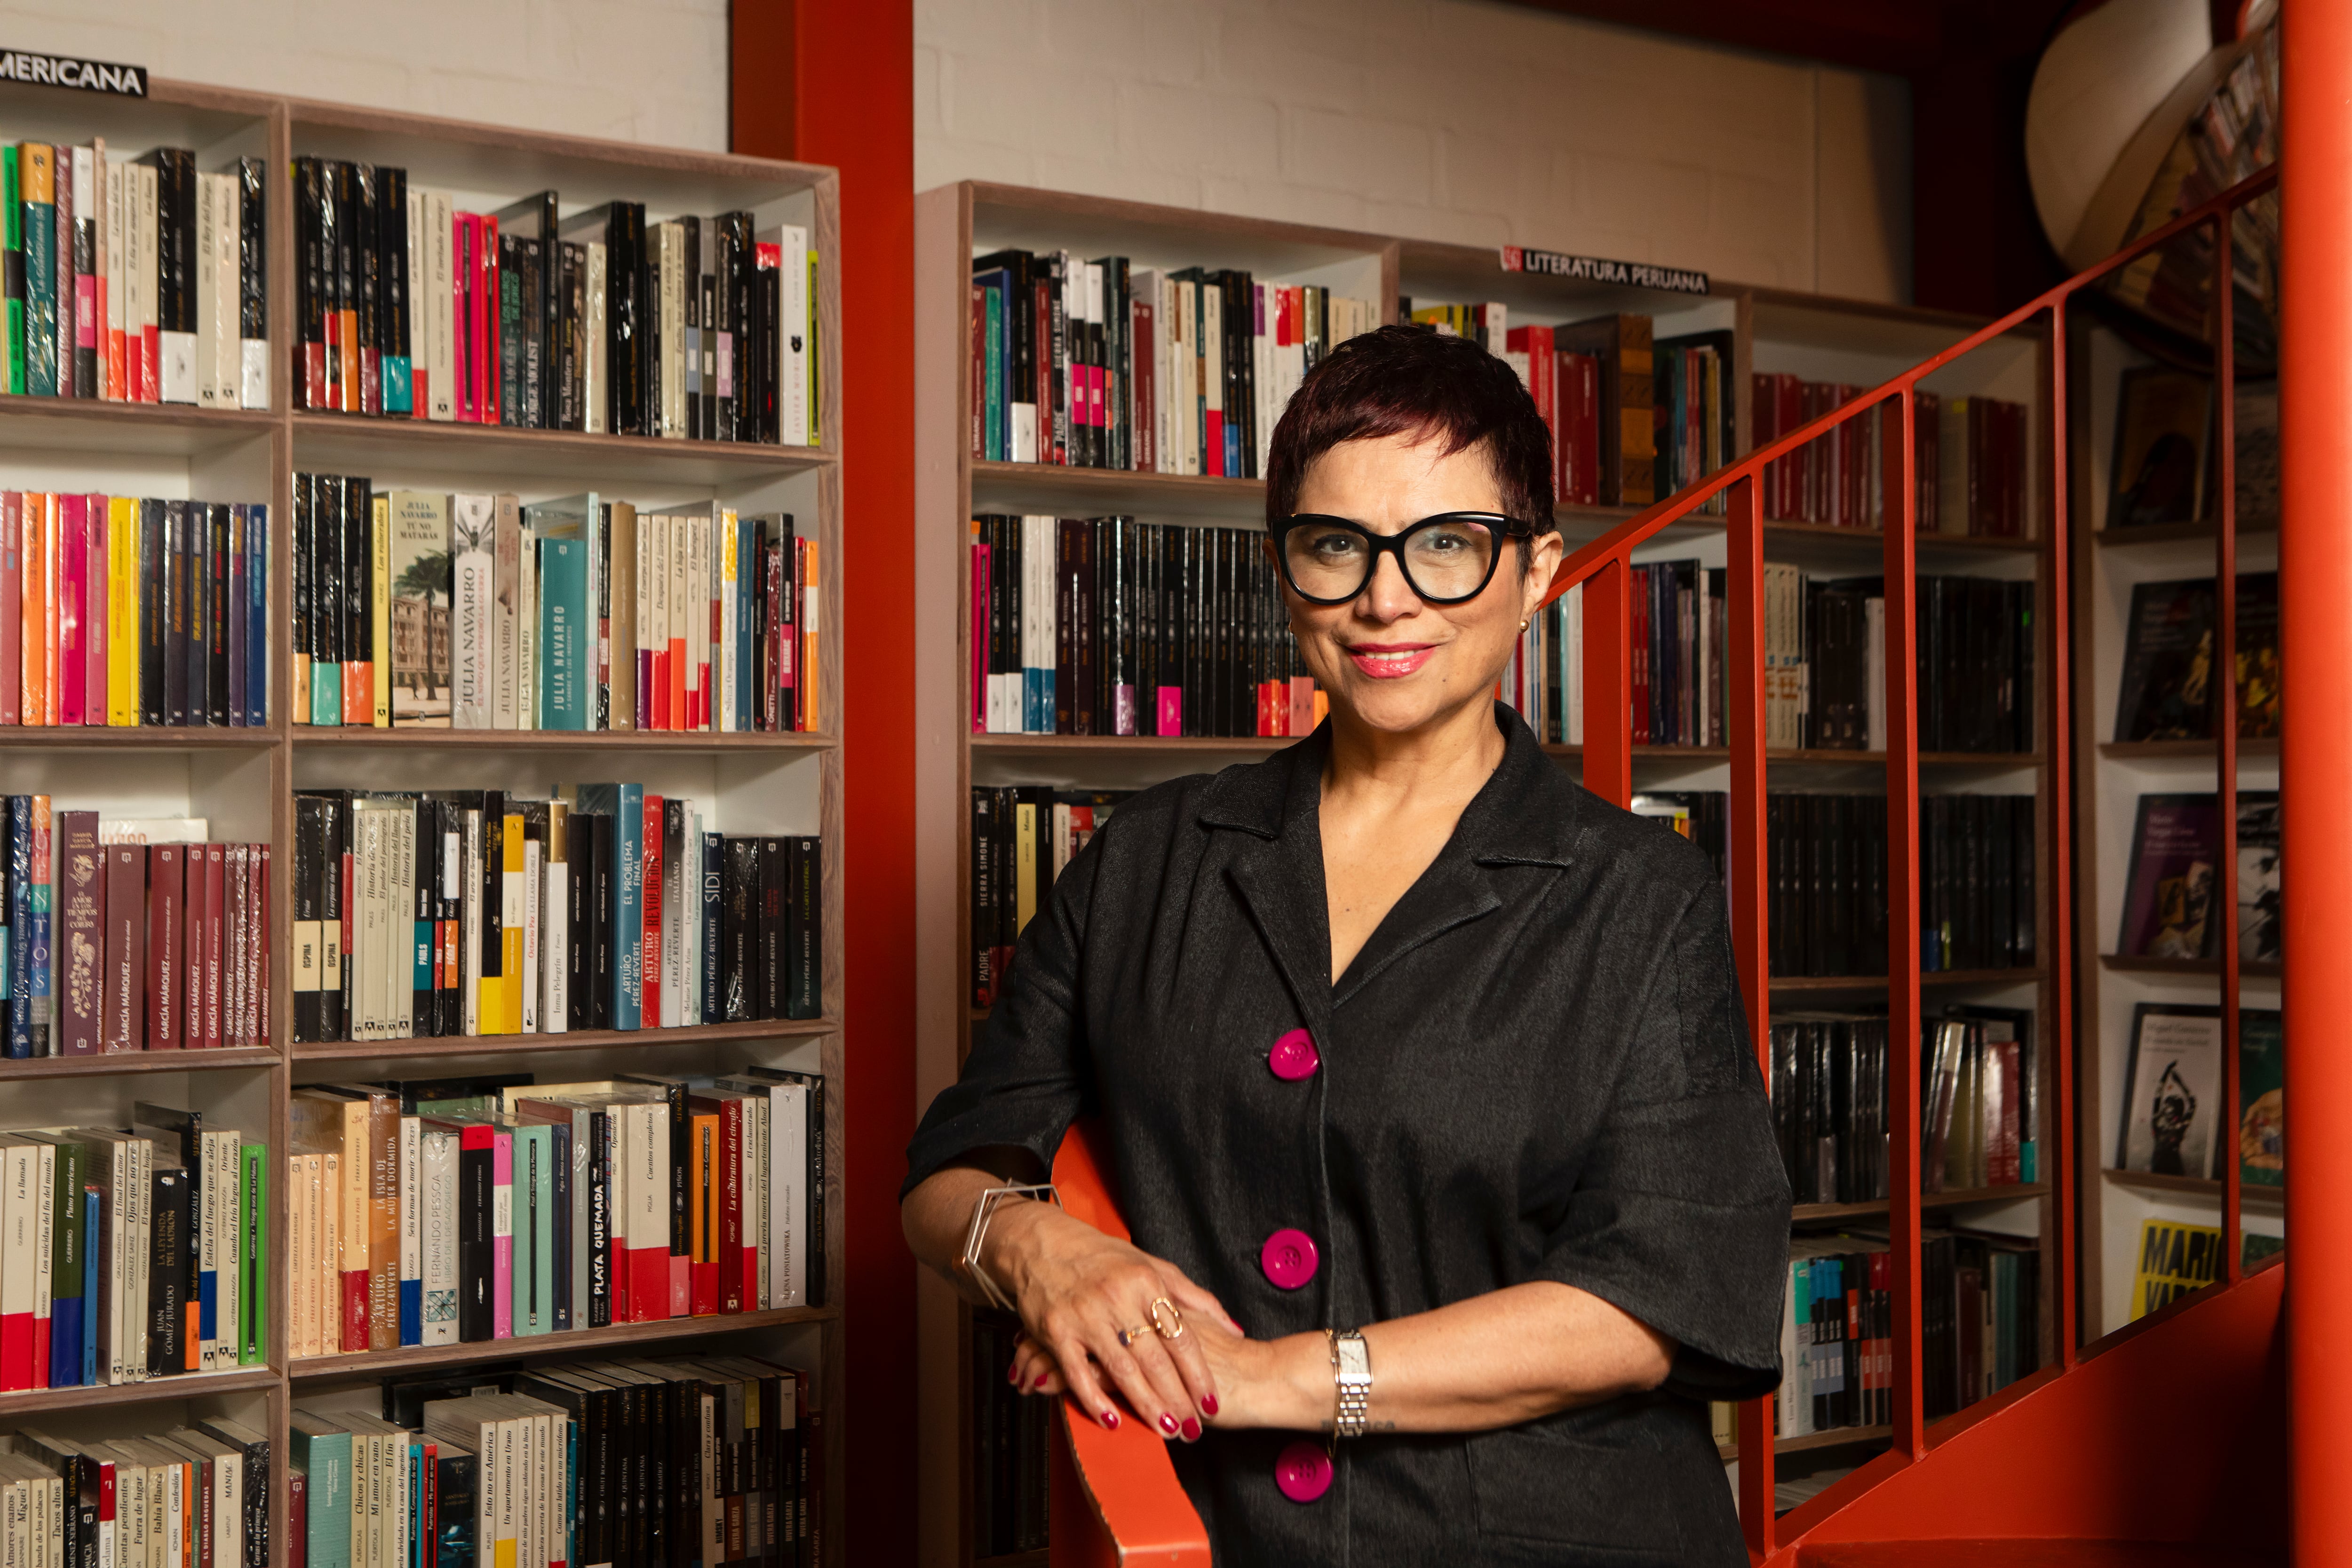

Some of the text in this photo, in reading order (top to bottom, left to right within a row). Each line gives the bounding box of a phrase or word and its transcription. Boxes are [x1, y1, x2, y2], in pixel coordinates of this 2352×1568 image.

[1526, 252, 1628, 283] LITERATURA
[1632, 266, 1707, 293] PERUANA
[504, 336, 516, 424] JORGE MOLIST
[527, 339, 538, 383] MOLIST
[527, 386, 538, 424] JORGE
[561, 355, 573, 422] Rosa Montero
[376, 506, 385, 551] vulnerables
[656, 560, 664, 572] del
[675, 567, 683, 578] La
[478, 605, 484, 616] LA
[657, 574, 666, 610] Después
[463, 567, 475, 706] JULIA NAVARRO
[501, 620, 511, 714] JULIA NAVARRO
[554, 605, 565, 710] JULIA NAVARRO
[478, 697, 485, 706] EL
[402, 852, 411, 888] Historia
[624, 841, 633, 904] EL PROBLEMA
[705, 872, 720, 902] SIDI
[530, 904, 534, 913] LA
[303, 944, 311, 968] OSPINA
[419, 944, 427, 965] PAULS
[632, 941, 641, 1006] PÉREZ-REVERTE
[645, 931, 654, 982] ARTURO
[979, 950, 989, 981] PADRE
[119, 962, 131, 1041] GARCÍA MÁRQUEZ
[159, 960, 171, 1039] GARCÍA MÁRQUEZ
[191, 965, 200, 1037] GARCÍA MÁRQUEZ
[208, 960, 219, 1038] GARCÍA MÁRQUEZ
[18, 1158, 26, 1200] La llamada
[207, 1163, 214, 1172] se
[207, 1175, 215, 1191] que
[376, 1159, 386, 1209] LA ISLA DE
[387, 1137, 396, 1230] LA MUJER DORMIDA
[191, 1190, 199, 1228] GONZÁLEZ
[206, 1194, 215, 1220] fuego
[230, 1181, 239, 1205] llegue
[205, 1222, 214, 1236] del
[229, 1207, 238, 1221] frío
[432, 1175, 441, 1283] FERNANDO PESSOA
[157, 1212, 166, 1266] LA LEYENDA
[165, 1210, 175, 1266] DEL LADRÓN
[205, 1239, 214, 1267] Estela
[594, 1185, 604, 1295] PLATA QUEMADA
[2142, 1226, 2222, 1281] MARI
[376, 1274, 385, 1317] ARTURO
[387, 1261, 396, 1328] PÉREZ-REVERTE
[164, 1285, 175, 1355] GÓMEZ-JURADO
[355, 1445, 364, 1473] chicas
[385, 1443, 394, 1467] El fin
[485, 1432, 493, 1469] América
[171, 1473, 180, 1512] Confesión
[486, 1472, 493, 1481] es
[486, 1484, 493, 1494] no
[503, 1430, 512, 1525] Un apartamento en Urano
[52, 1486, 61, 1538] Tacos altos
[355, 1483, 365, 1514] Chicos
[153, 1506, 162, 1533] Bahía
[6, 1530, 15, 1568] Amores
[204, 1550, 208, 1559] EL
